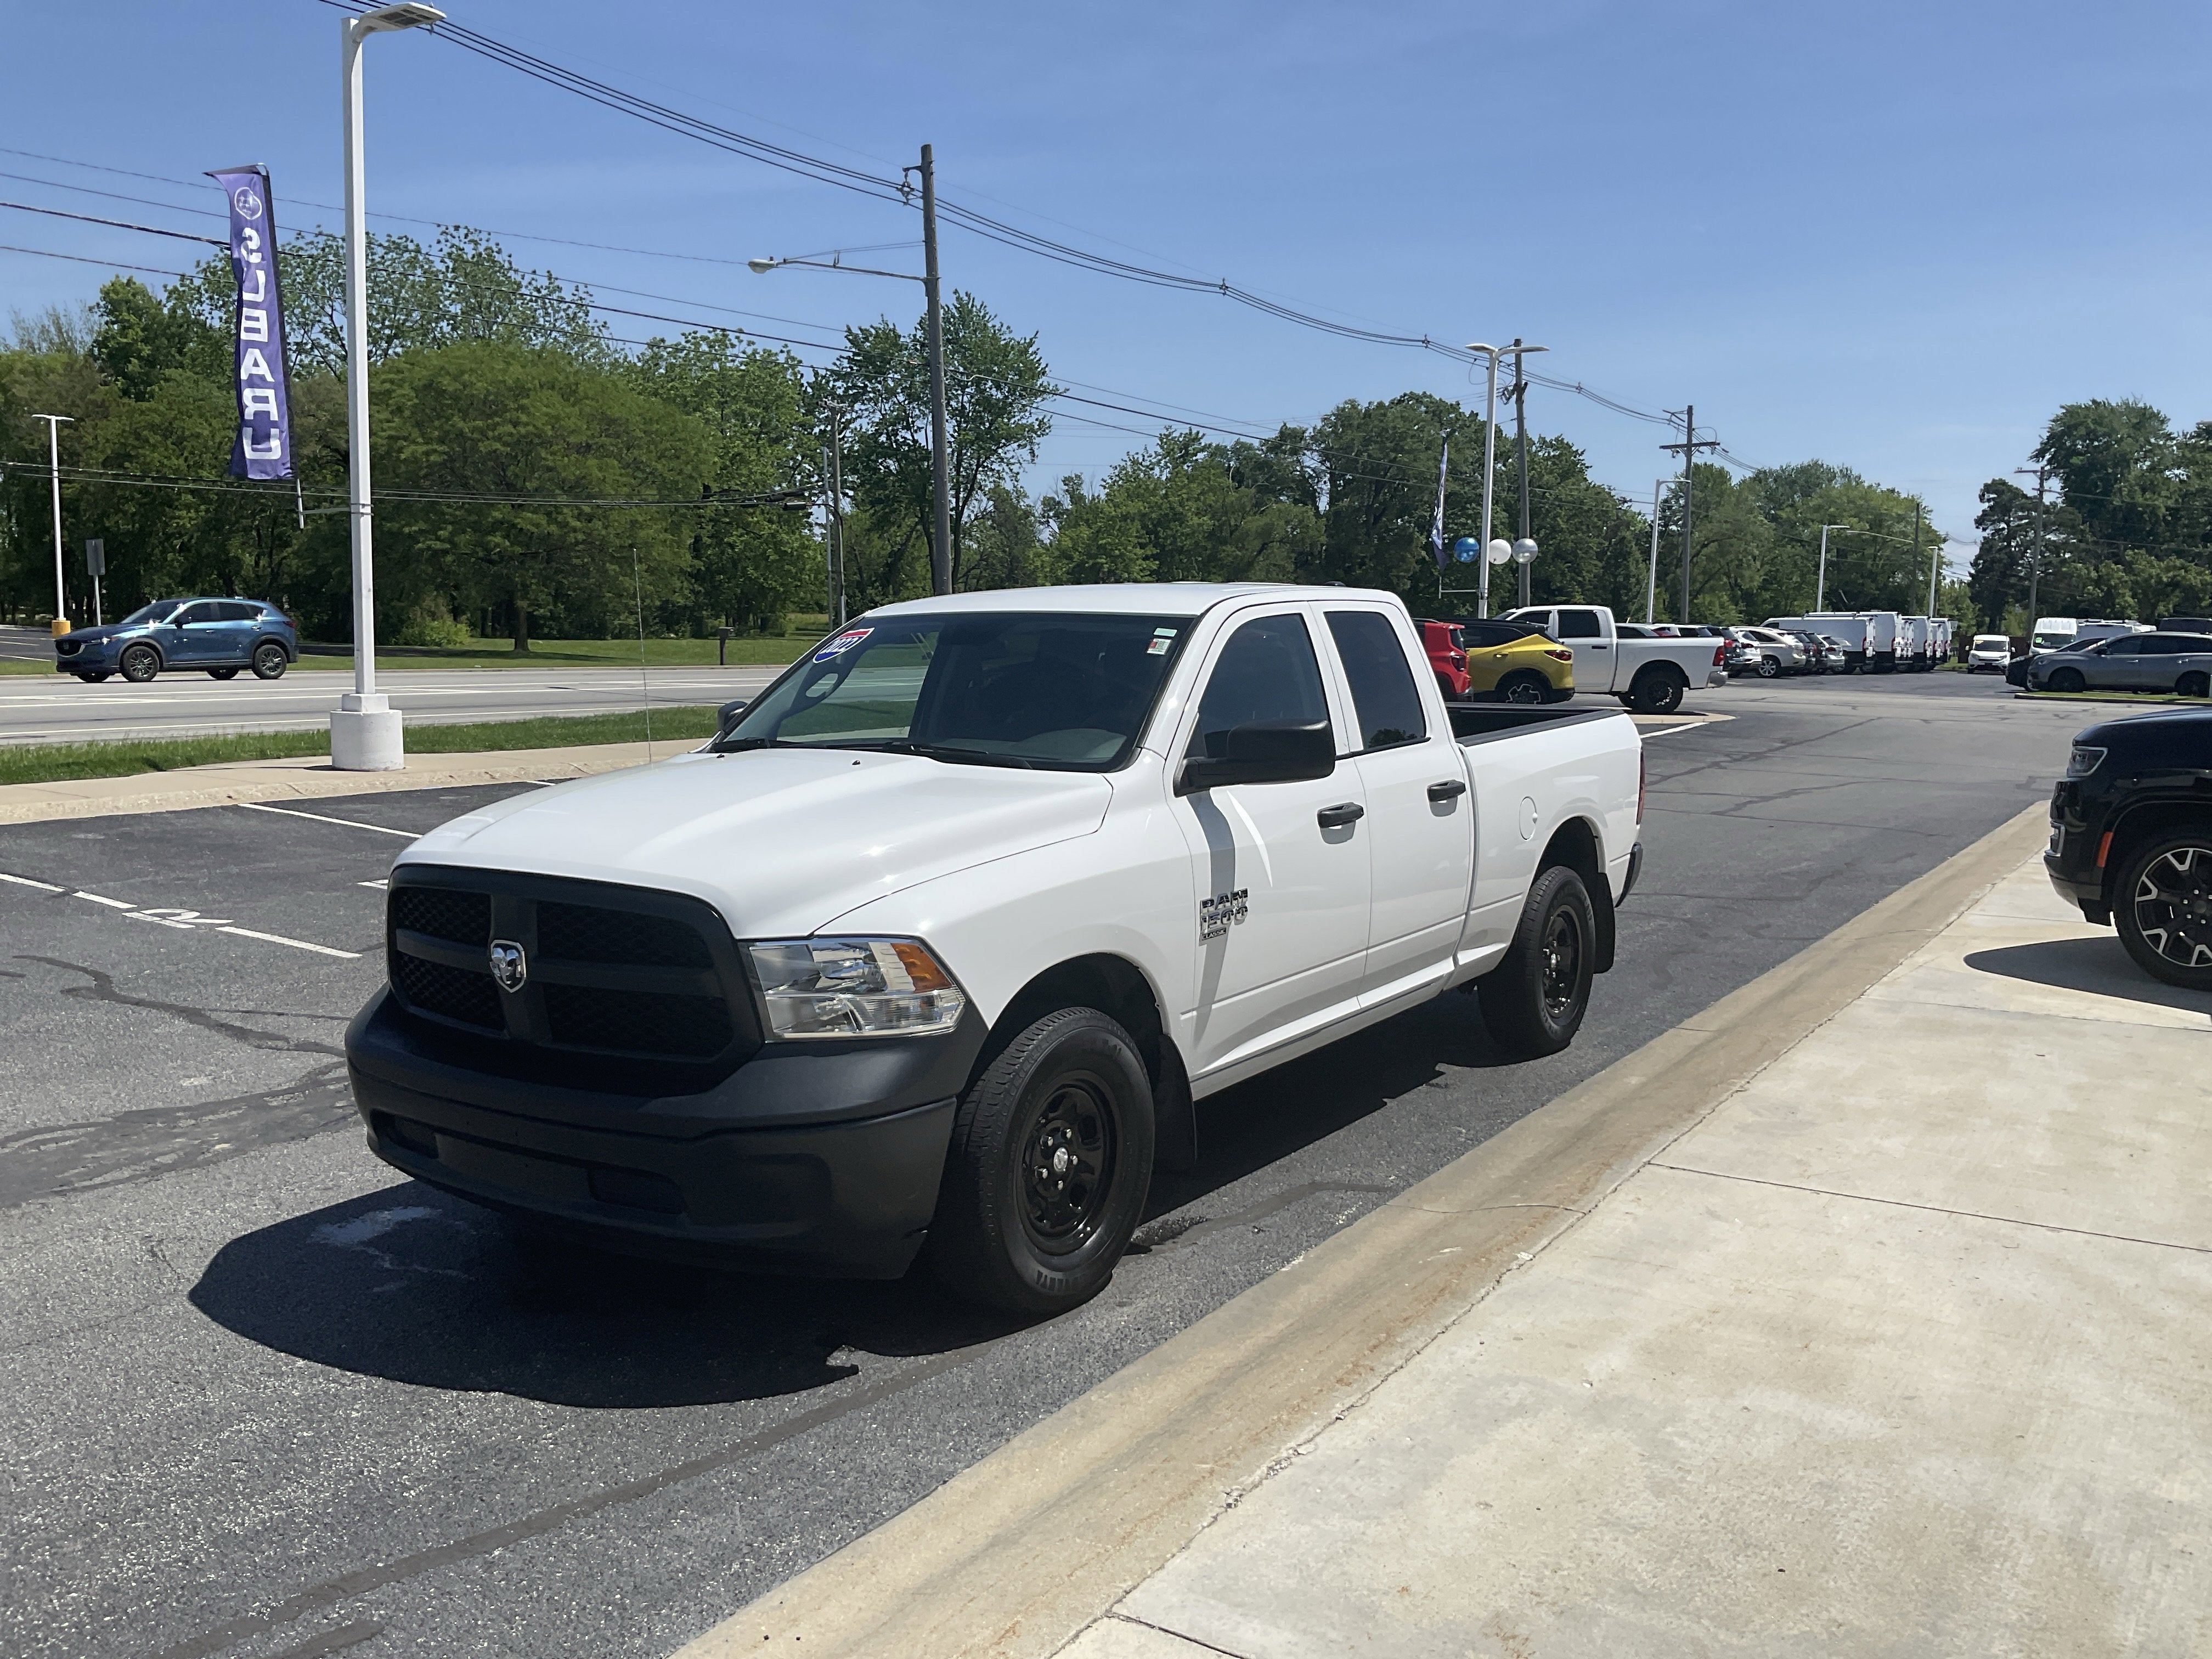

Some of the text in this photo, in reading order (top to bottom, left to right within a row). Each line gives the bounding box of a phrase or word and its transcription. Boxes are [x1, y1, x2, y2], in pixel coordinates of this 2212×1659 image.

[1200, 888, 1248, 915] RAM
[1200, 905, 1248, 933] 1500
[1202, 929, 1227, 940] CLASSIC
